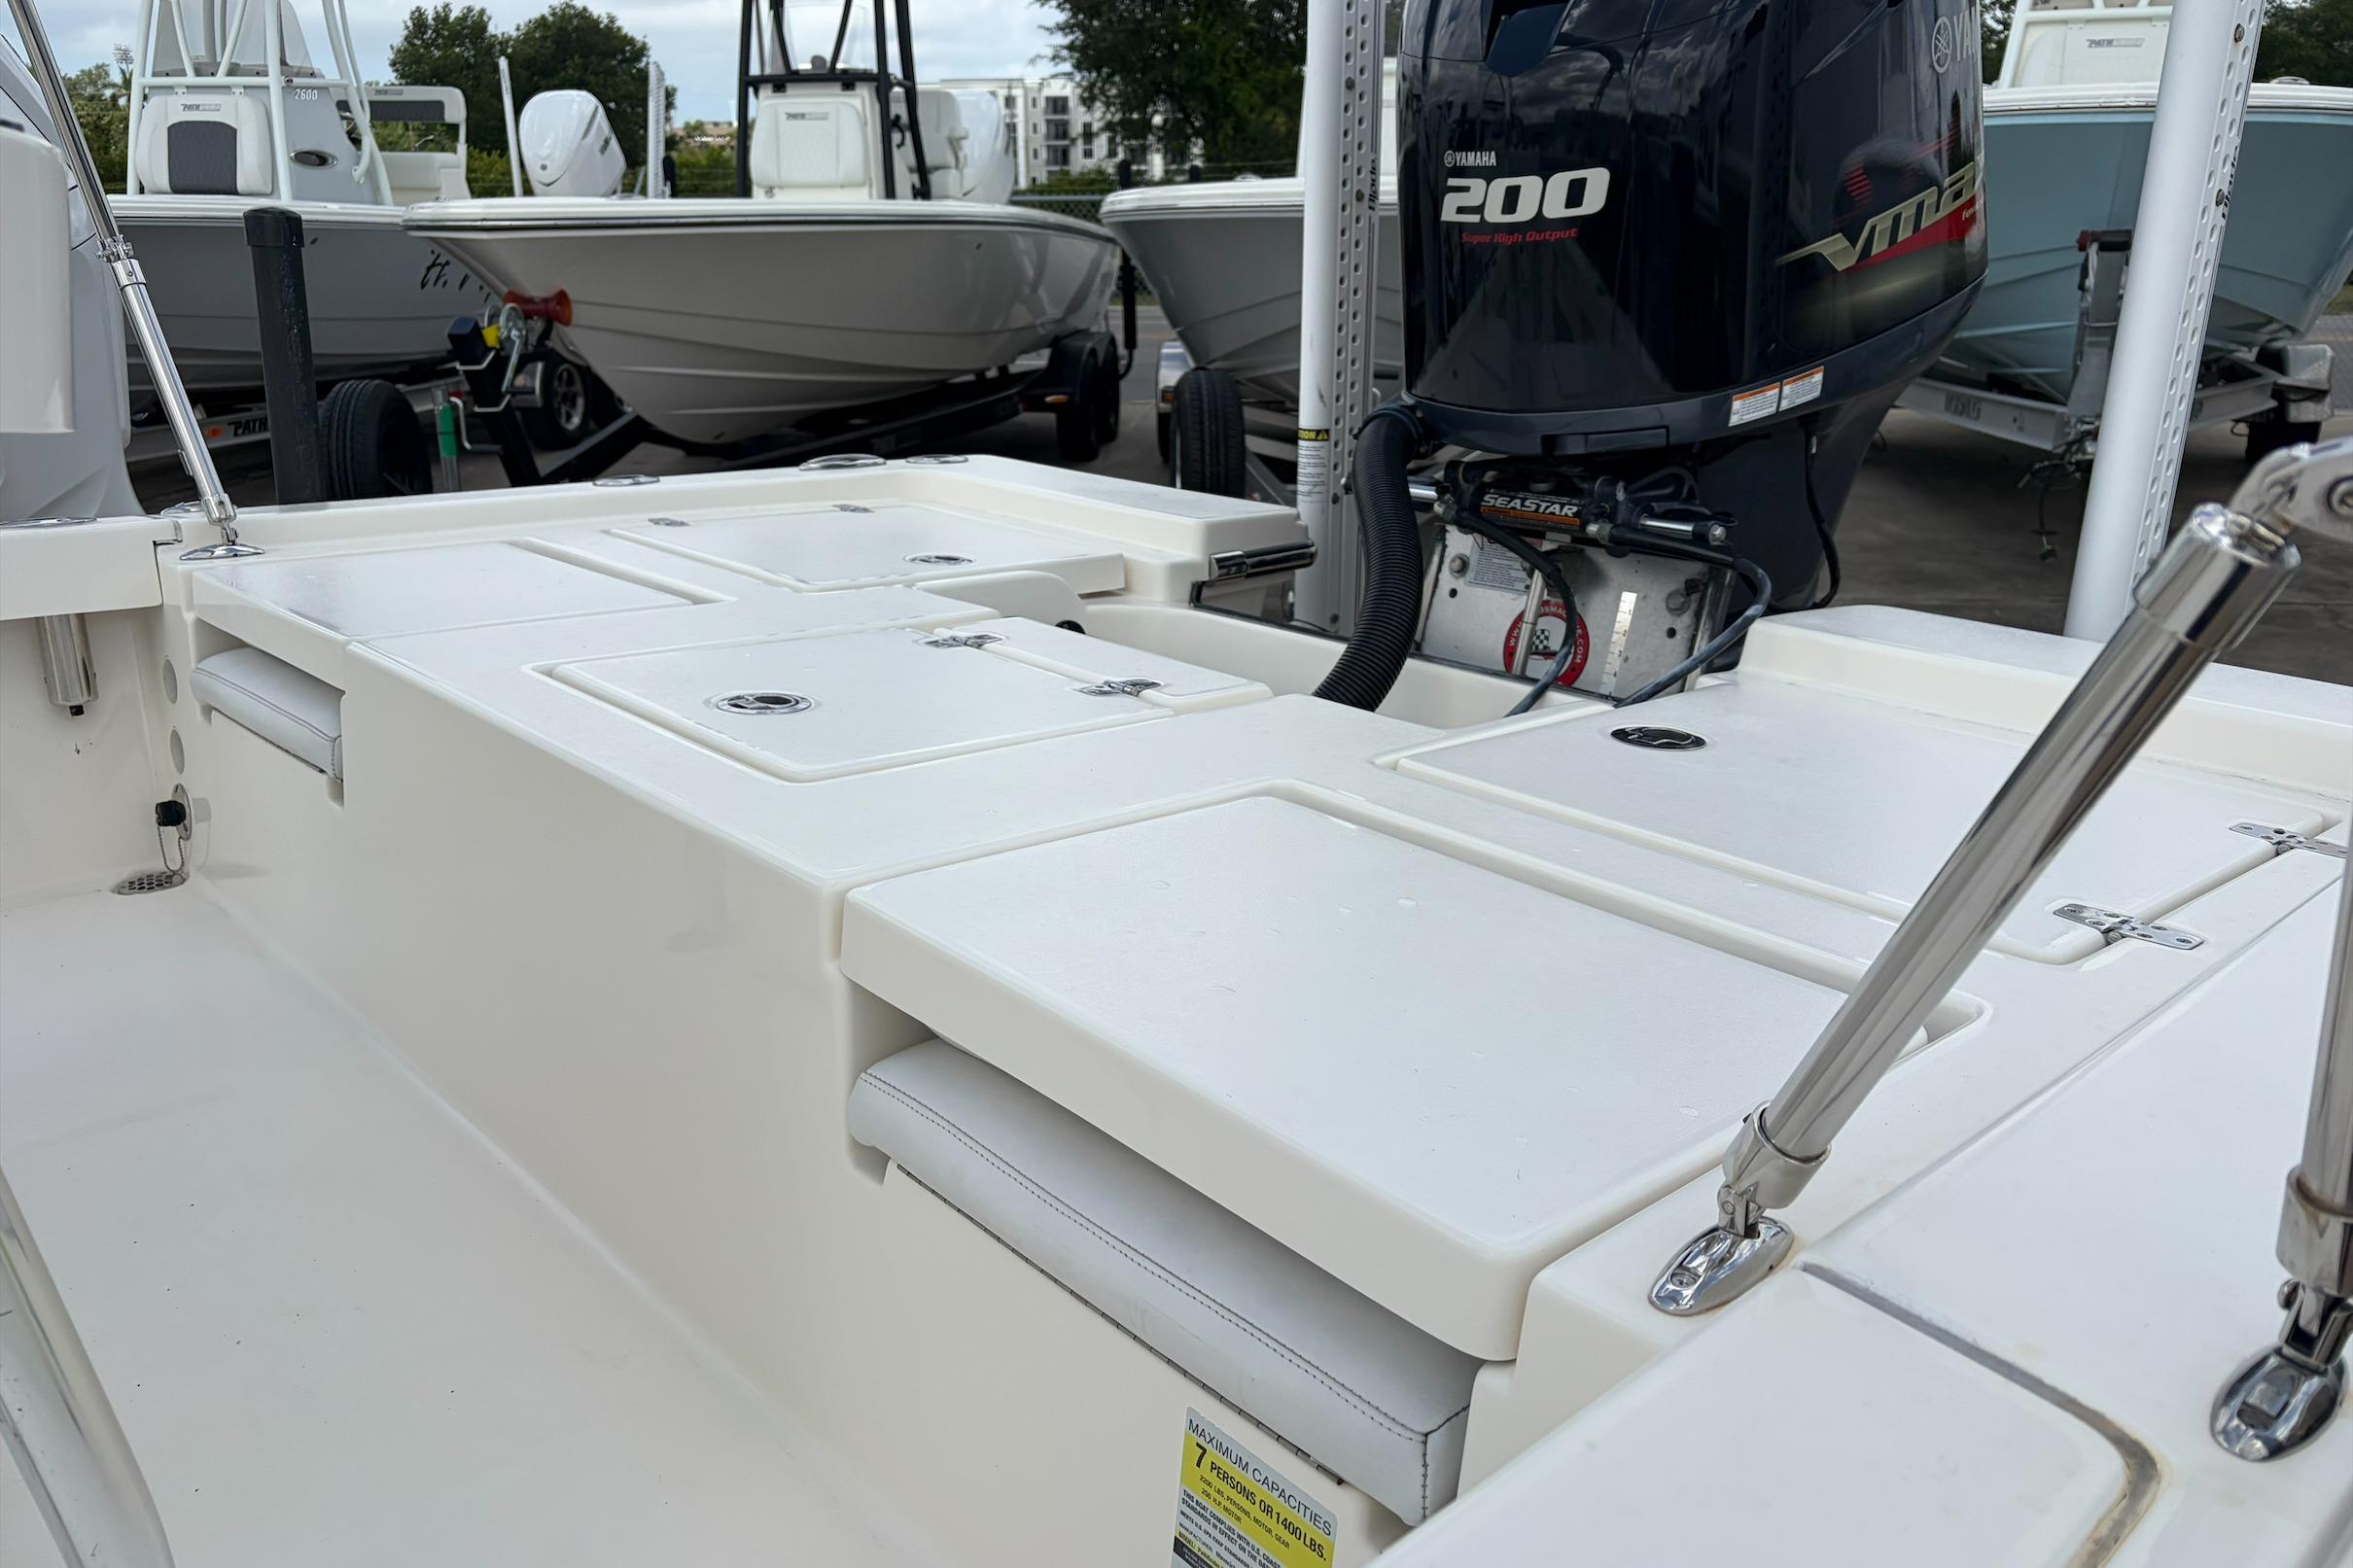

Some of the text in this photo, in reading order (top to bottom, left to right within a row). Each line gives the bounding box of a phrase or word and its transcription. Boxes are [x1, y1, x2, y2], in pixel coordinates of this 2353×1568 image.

[295, 89, 318, 101] 2600
[1456, 151, 1497, 167] YAMAHA
[1440, 166, 1611, 224] 200
[1461, 227, 1579, 245] Super High Output
[1480, 494, 1579, 517] SEASTAR
[1188, 1418, 1332, 1536] MAXIMUM CAPACITIES
[1194, 1442, 1327, 1560] 7 PERSONS OR 1400 LBS.
[1182, 1489, 1195, 1503] THIS
[1195, 1500, 1209, 1514] BOAT
[1209, 1511, 1236, 1535] COMPLIES
[1236, 1532, 1250, 1548] WITH
[1222, 1506, 1243, 1524] MOTOR
[1181, 1498, 1212, 1526] STANDARDS
[1212, 1521, 1218, 1531] IN
[1218, 1527, 1238, 1547] EFFECT
[1247, 1551, 1259, 1564] THE
[1275, 1534, 1290, 1550] GEAR
